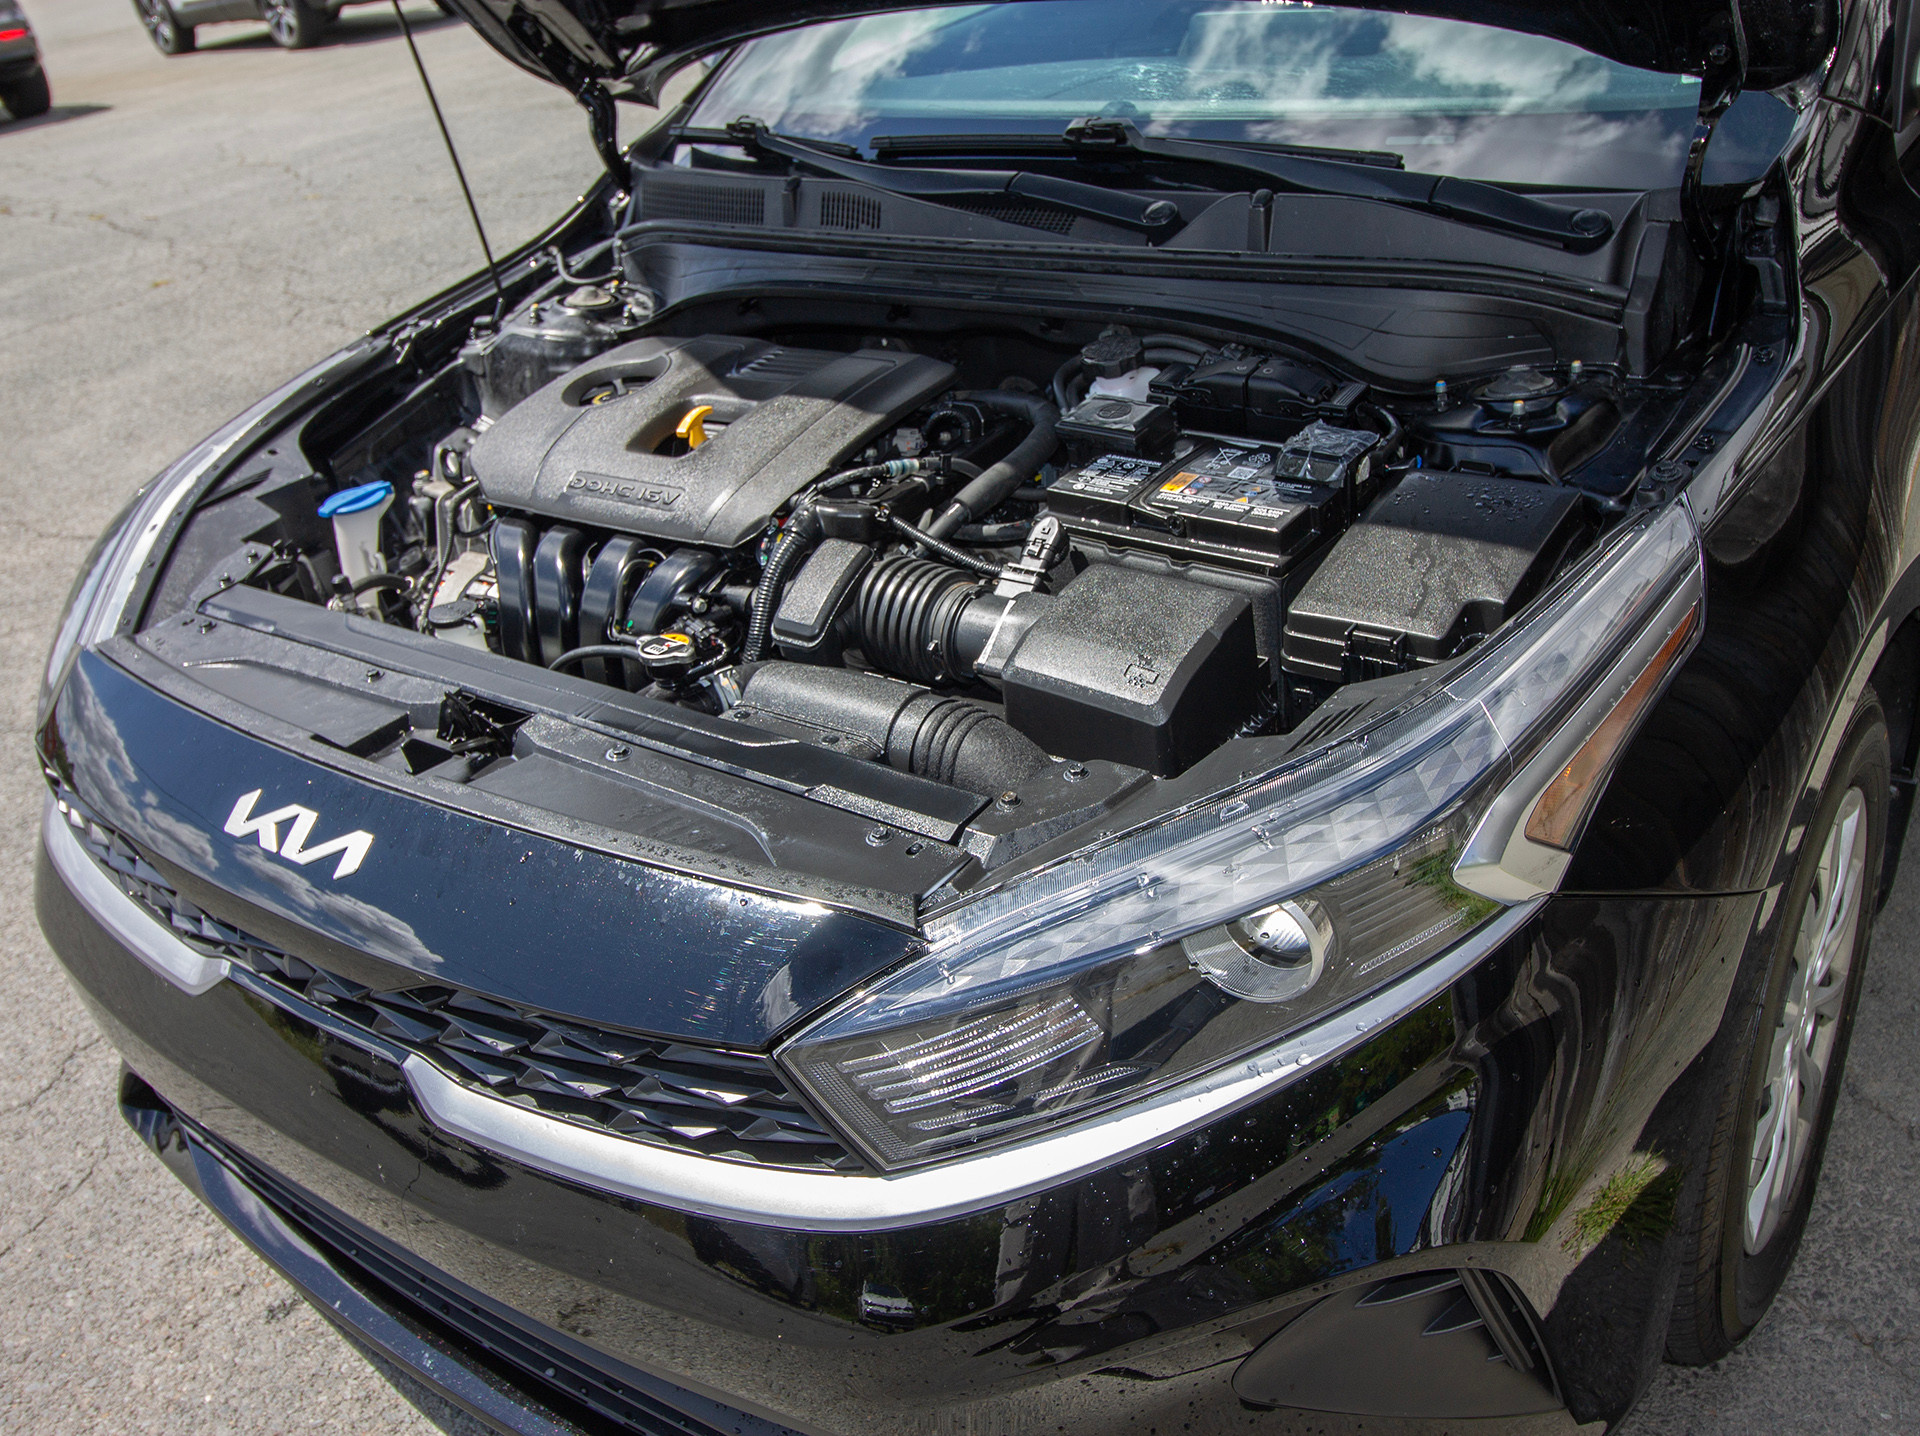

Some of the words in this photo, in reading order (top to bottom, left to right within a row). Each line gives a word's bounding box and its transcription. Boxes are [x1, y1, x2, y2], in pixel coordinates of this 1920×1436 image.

[569, 474, 635, 499] DOHC
[636, 486, 681, 506] 16V
[223, 788, 375, 880] KIA
